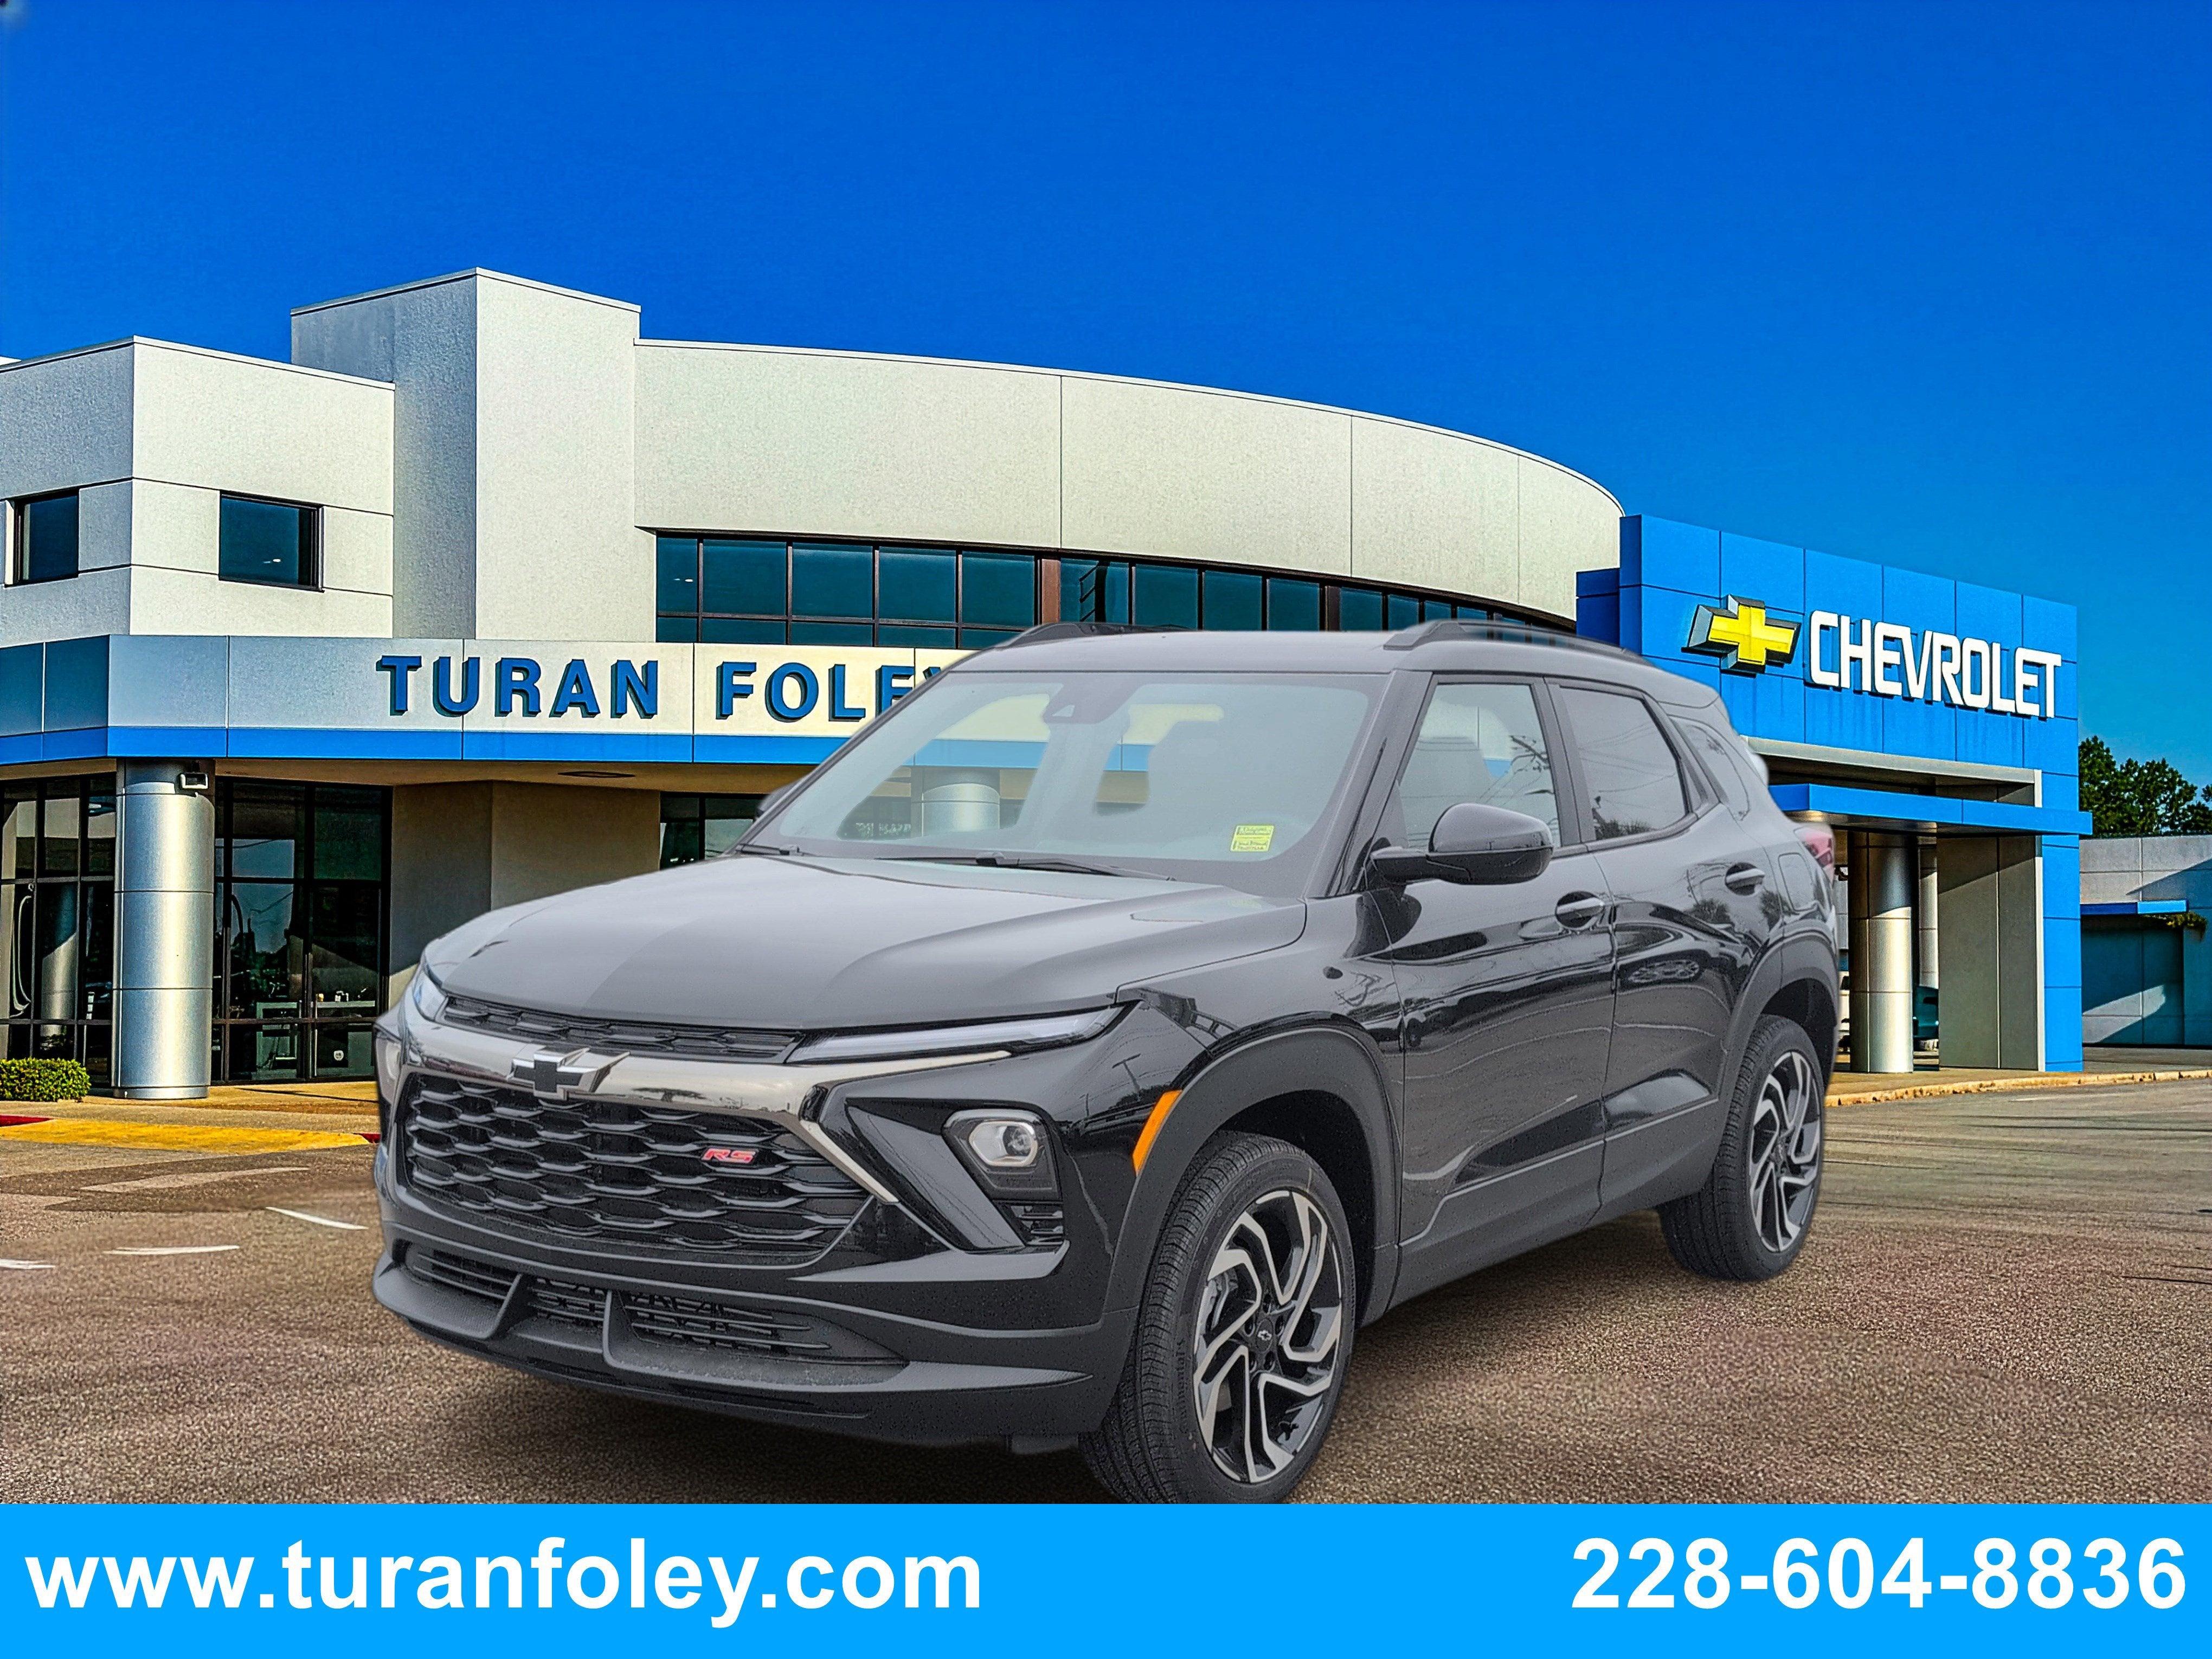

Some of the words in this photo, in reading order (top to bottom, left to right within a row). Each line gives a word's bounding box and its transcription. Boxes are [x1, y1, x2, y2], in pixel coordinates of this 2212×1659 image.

[377, 654, 659, 717] TURAN
[716, 660, 942, 722] FOLE
[1810, 610, 2062, 719] CHEVROLET
[700, 1147, 756, 1164] RS
